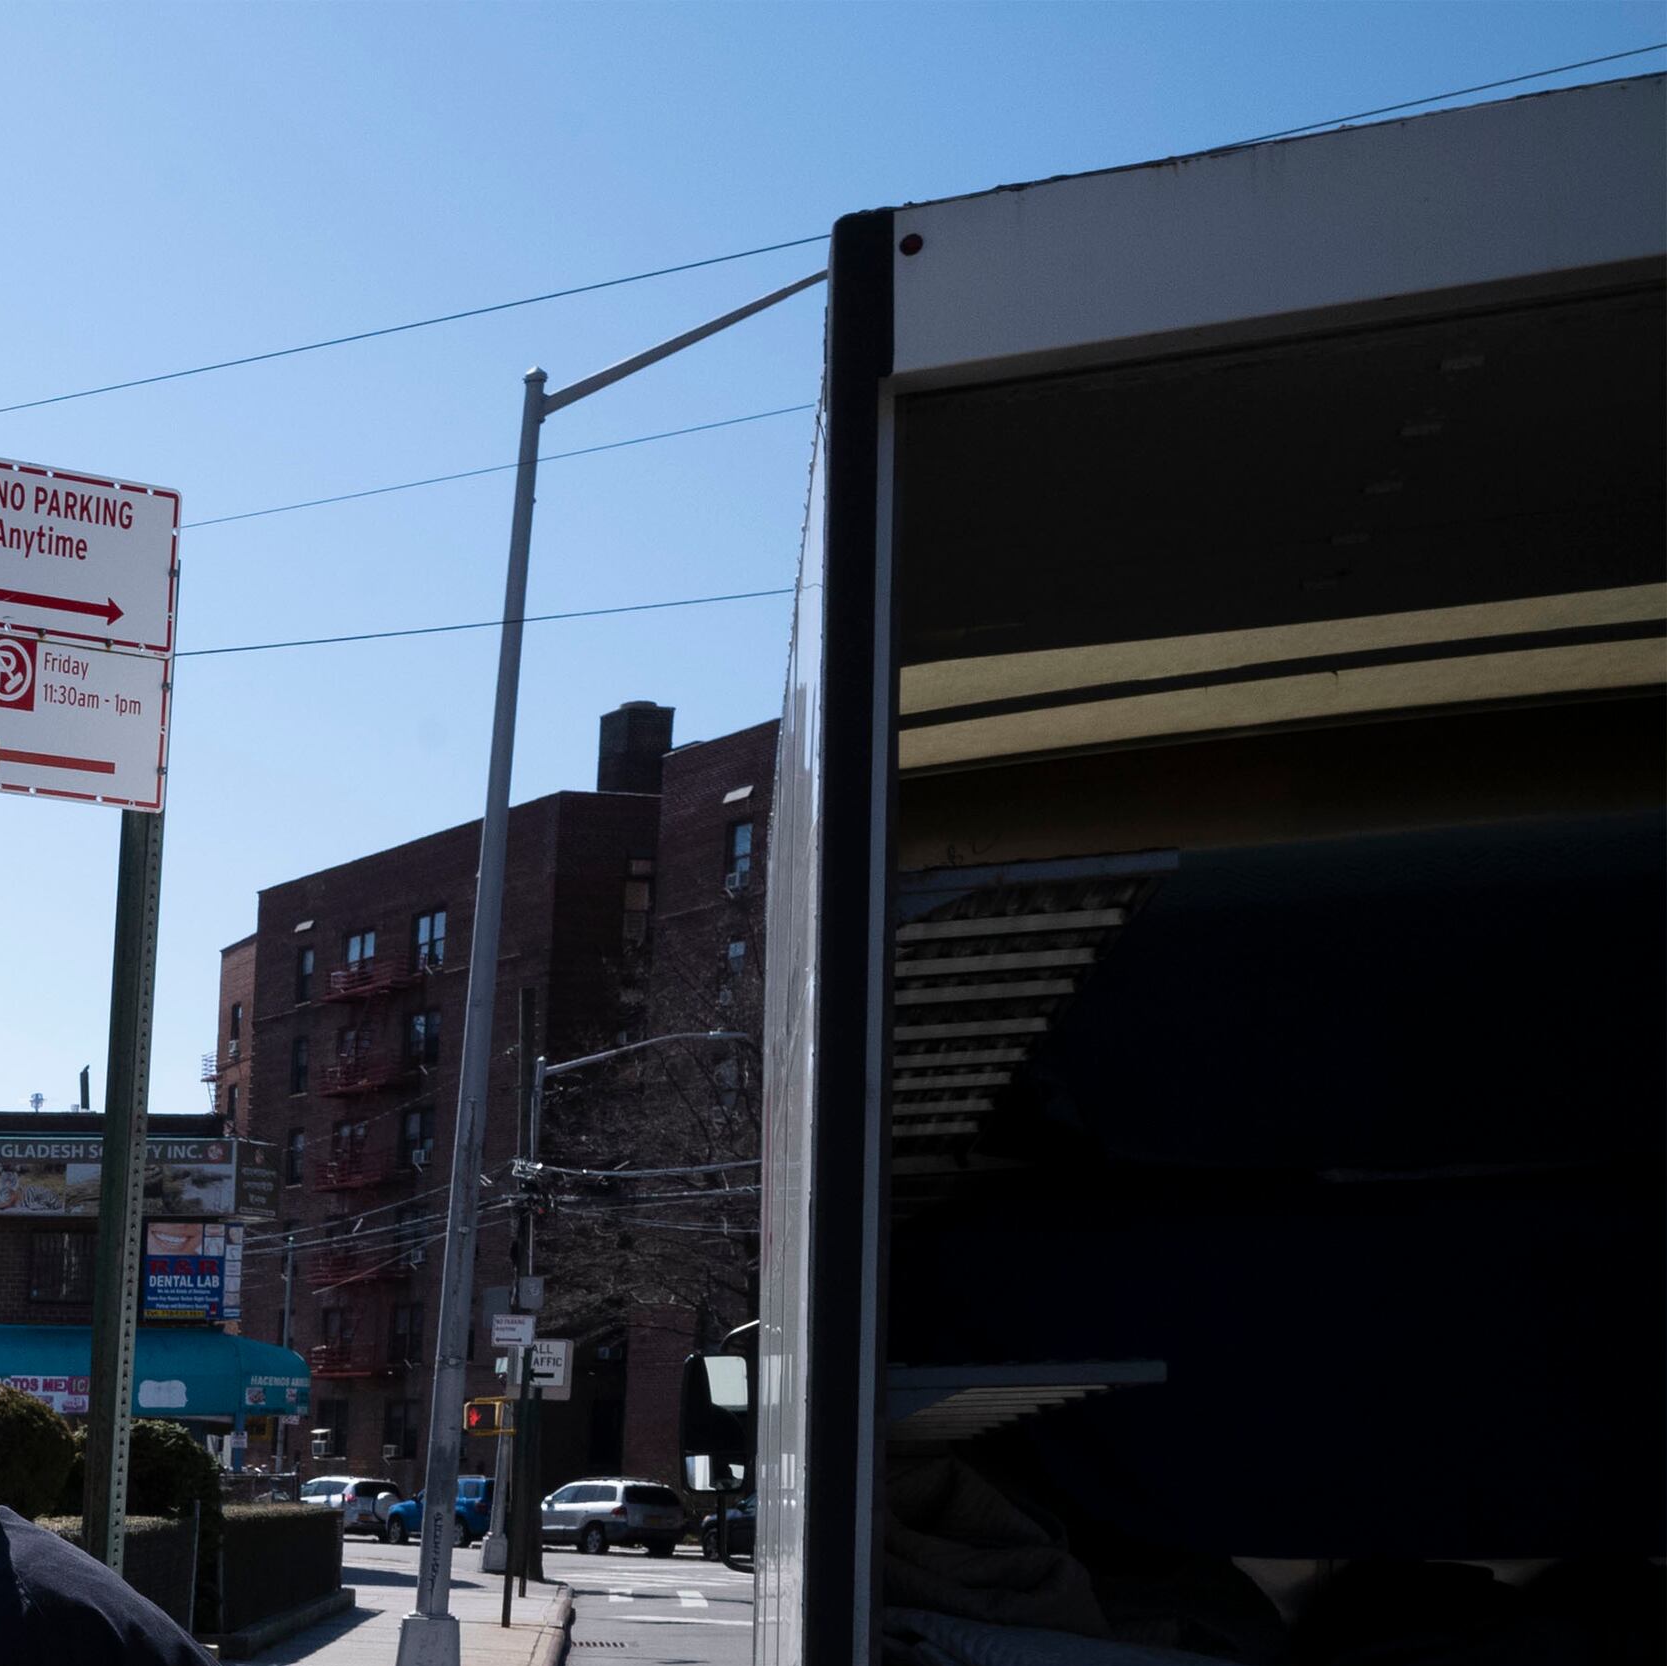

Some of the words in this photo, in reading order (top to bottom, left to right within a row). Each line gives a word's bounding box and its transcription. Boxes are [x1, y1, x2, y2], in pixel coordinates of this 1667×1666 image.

[34, 486, 134, 530] PARKING
[43, 652, 89, 681] Friday
[42, 683, 100, 709] 11:30am
[115, 693, 142, 717] 1pm
[167, 1145, 203, 1159] INC.
[149, 1274, 194, 1288] DENTAL
[196, 1274, 220, 1289] LAB
[532, 1344, 553, 1354] ALL
[42, 1377, 90, 1393] MEXIC
